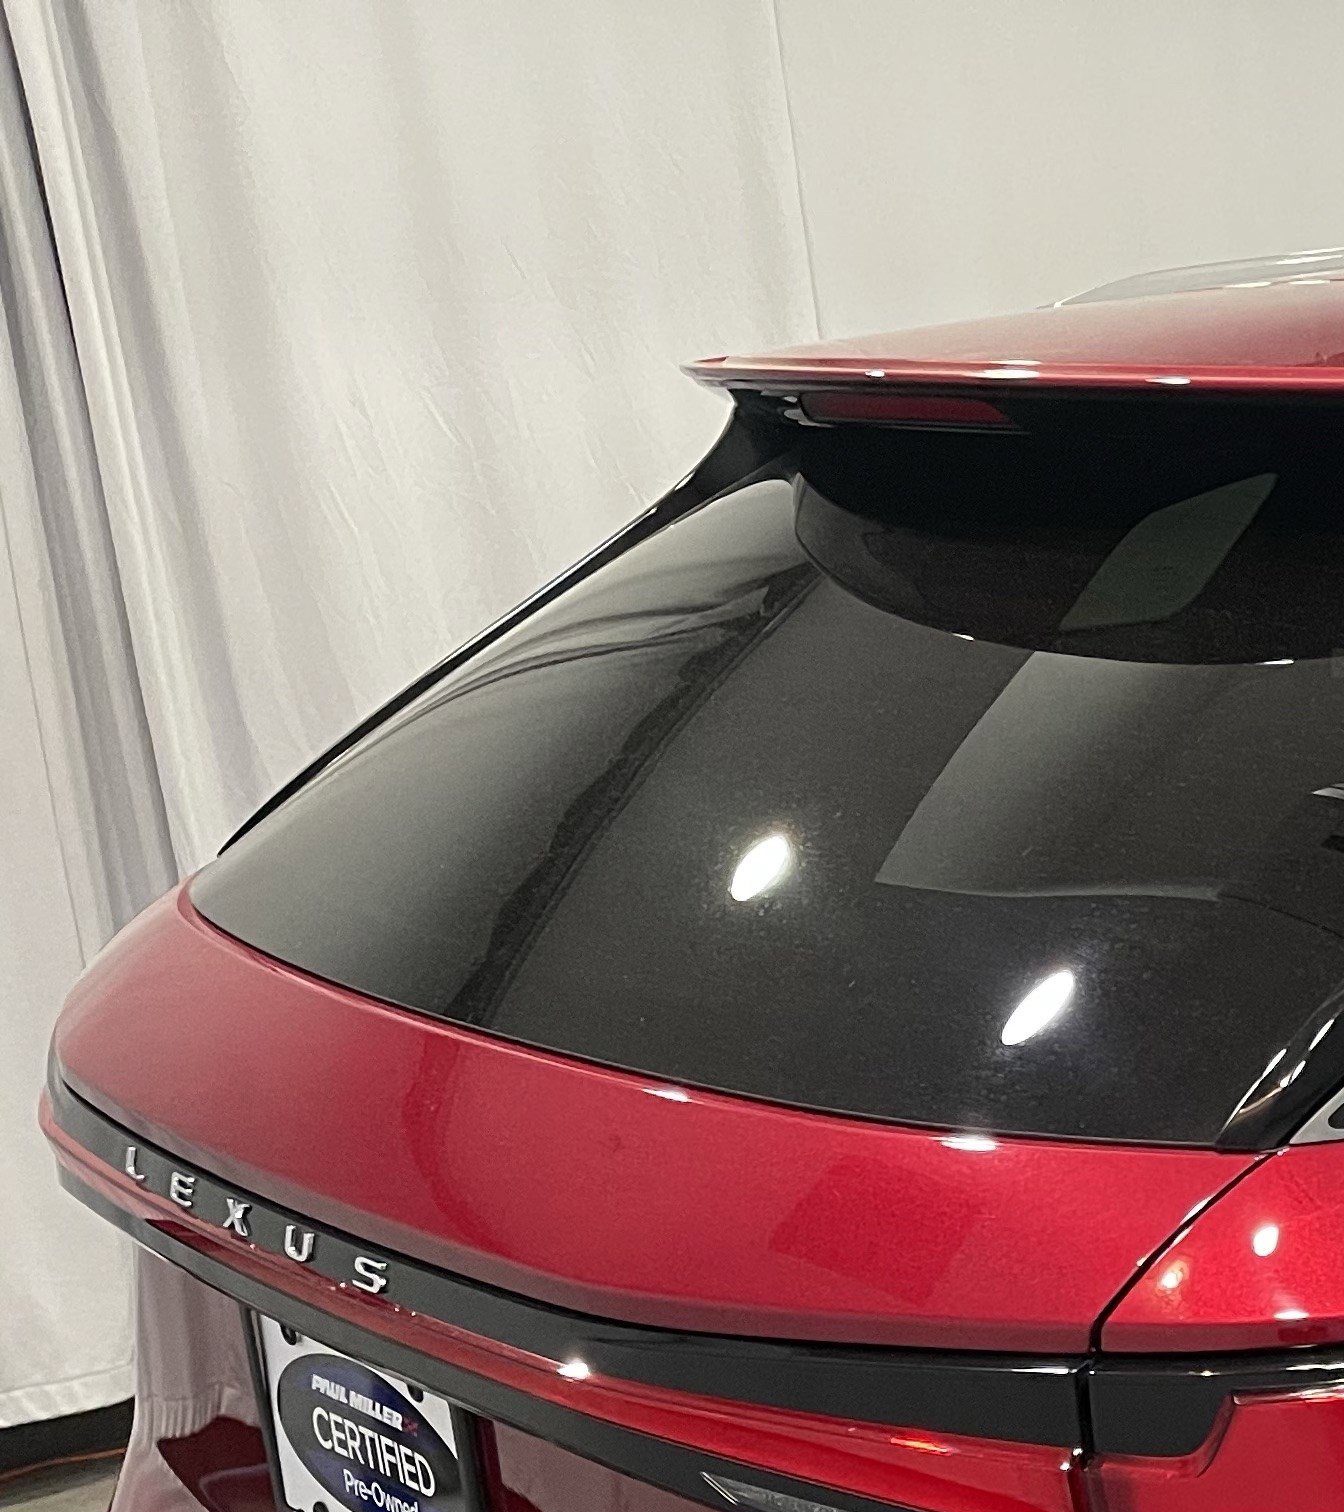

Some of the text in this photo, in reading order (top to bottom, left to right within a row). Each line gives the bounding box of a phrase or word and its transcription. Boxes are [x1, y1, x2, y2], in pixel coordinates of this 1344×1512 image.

[125, 1146, 388, 1294] LEXUS
[311, 1374, 402, 1431] PAUL MILLER
[312, 1406, 436, 1498] CERTIFIED
